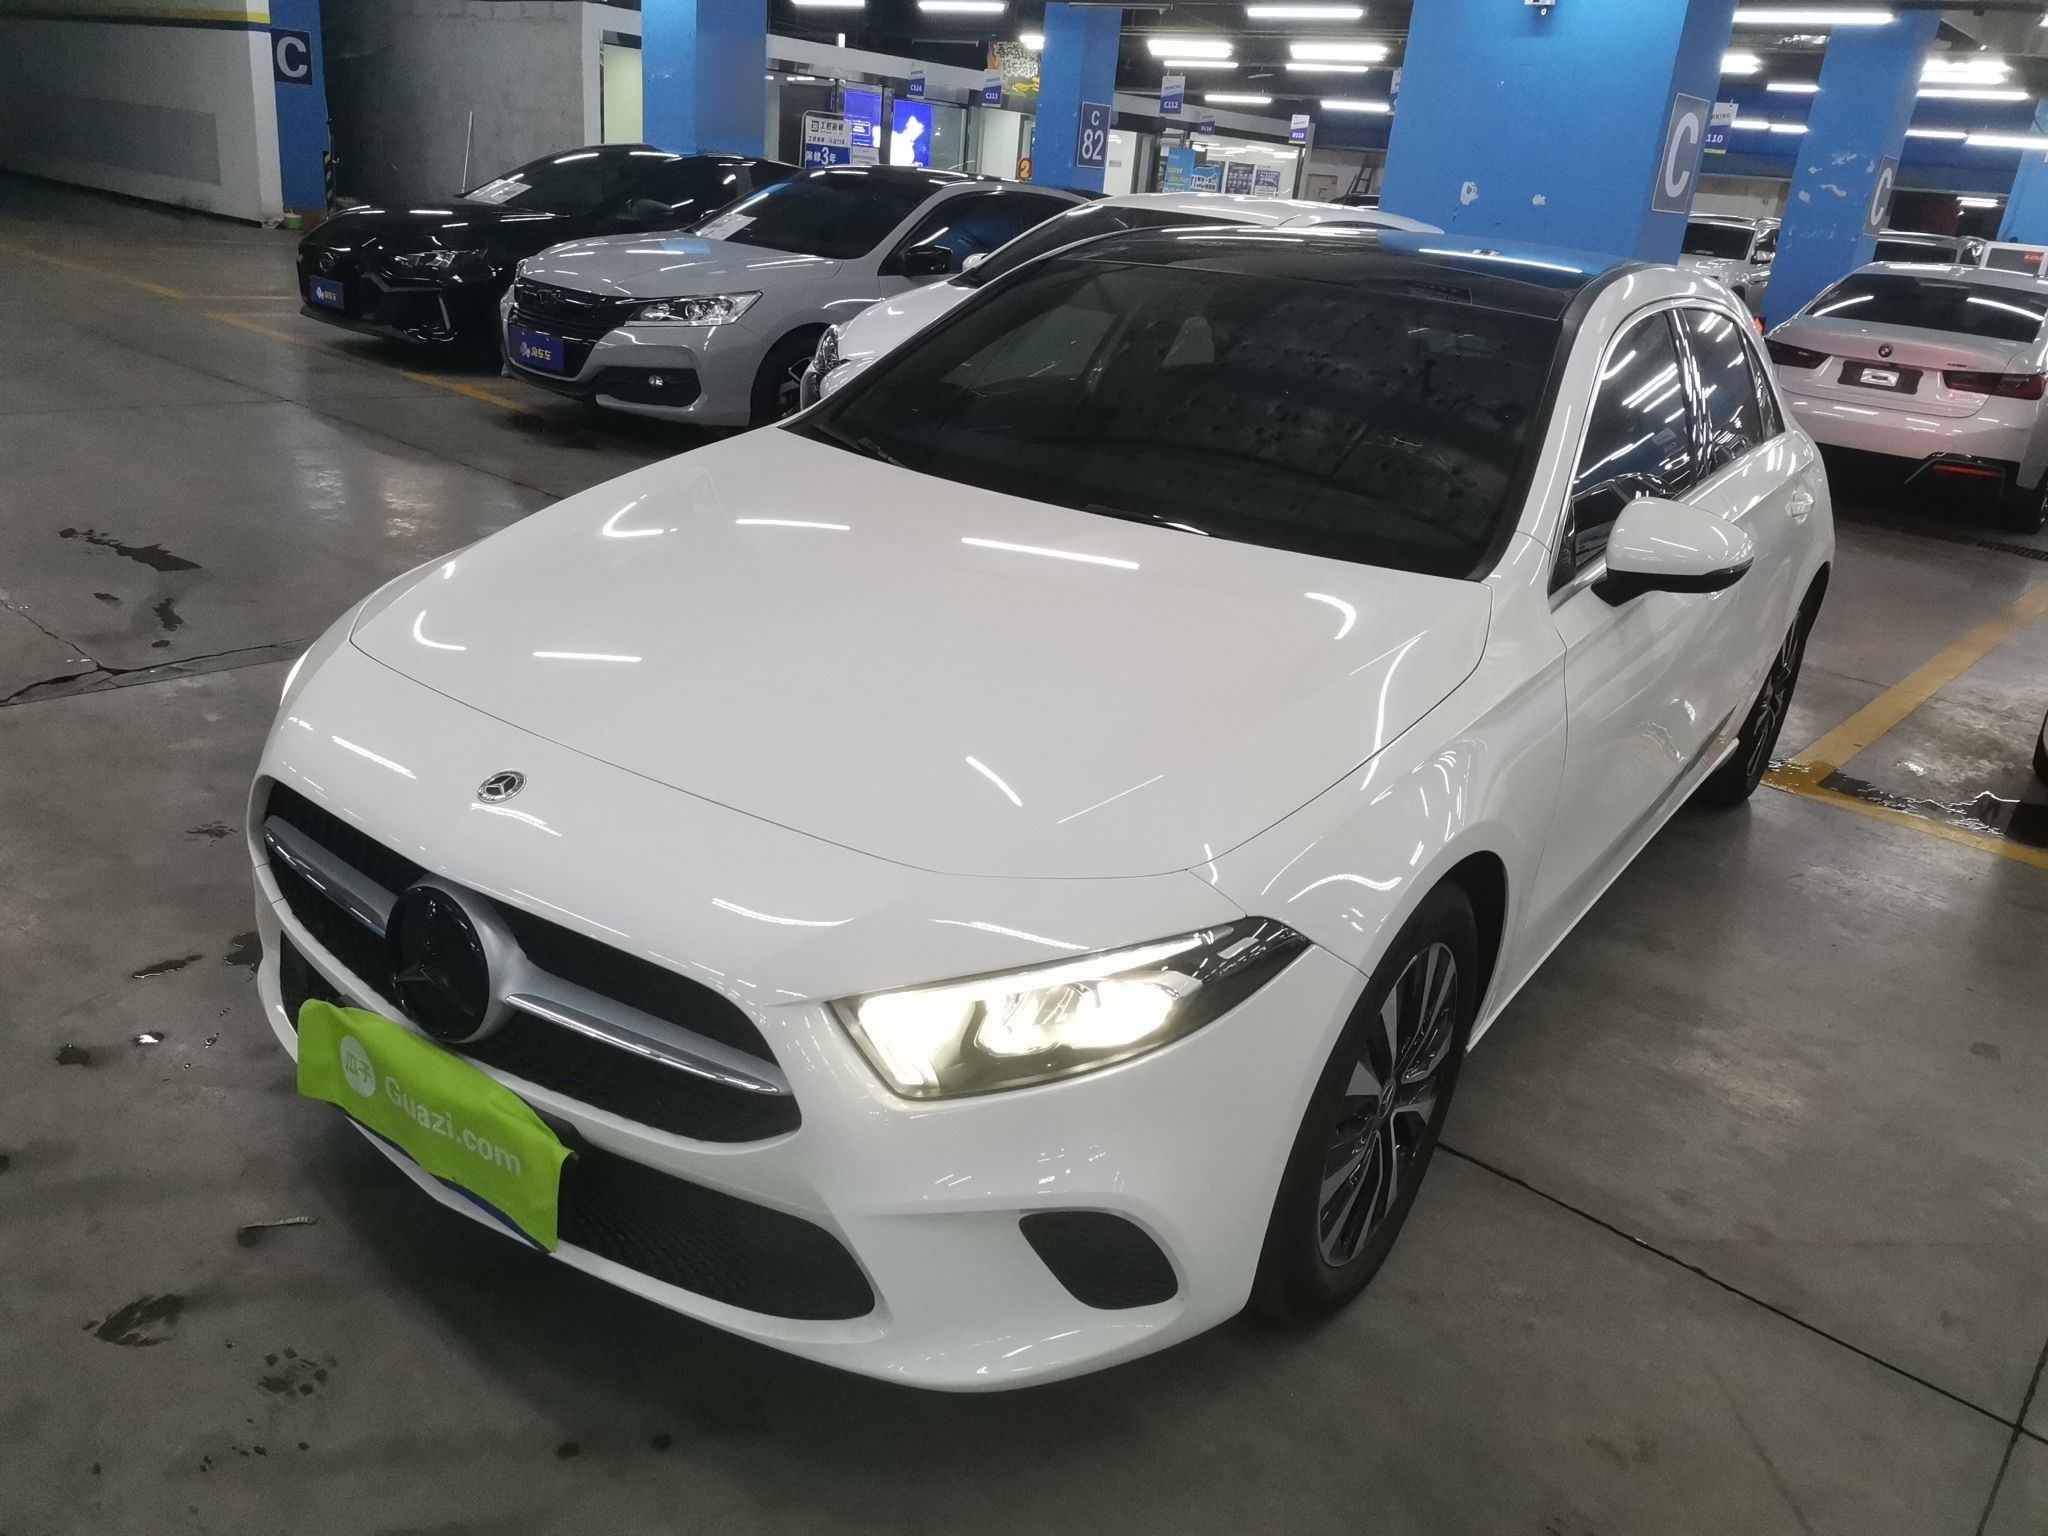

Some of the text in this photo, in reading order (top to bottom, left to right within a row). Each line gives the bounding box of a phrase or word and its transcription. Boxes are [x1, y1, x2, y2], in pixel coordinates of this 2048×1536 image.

[276, 36, 308, 78] C
[1091, 110, 1101, 126] C
[1082, 128, 1104, 160] 82
[1664, 112, 1699, 198] C
[1020, 159, 1030, 178] 2
[1870, 167, 1893, 226] C
[345, 1052, 372, 1082] 瓜子
[384, 1075, 522, 1178] Guazi.com
